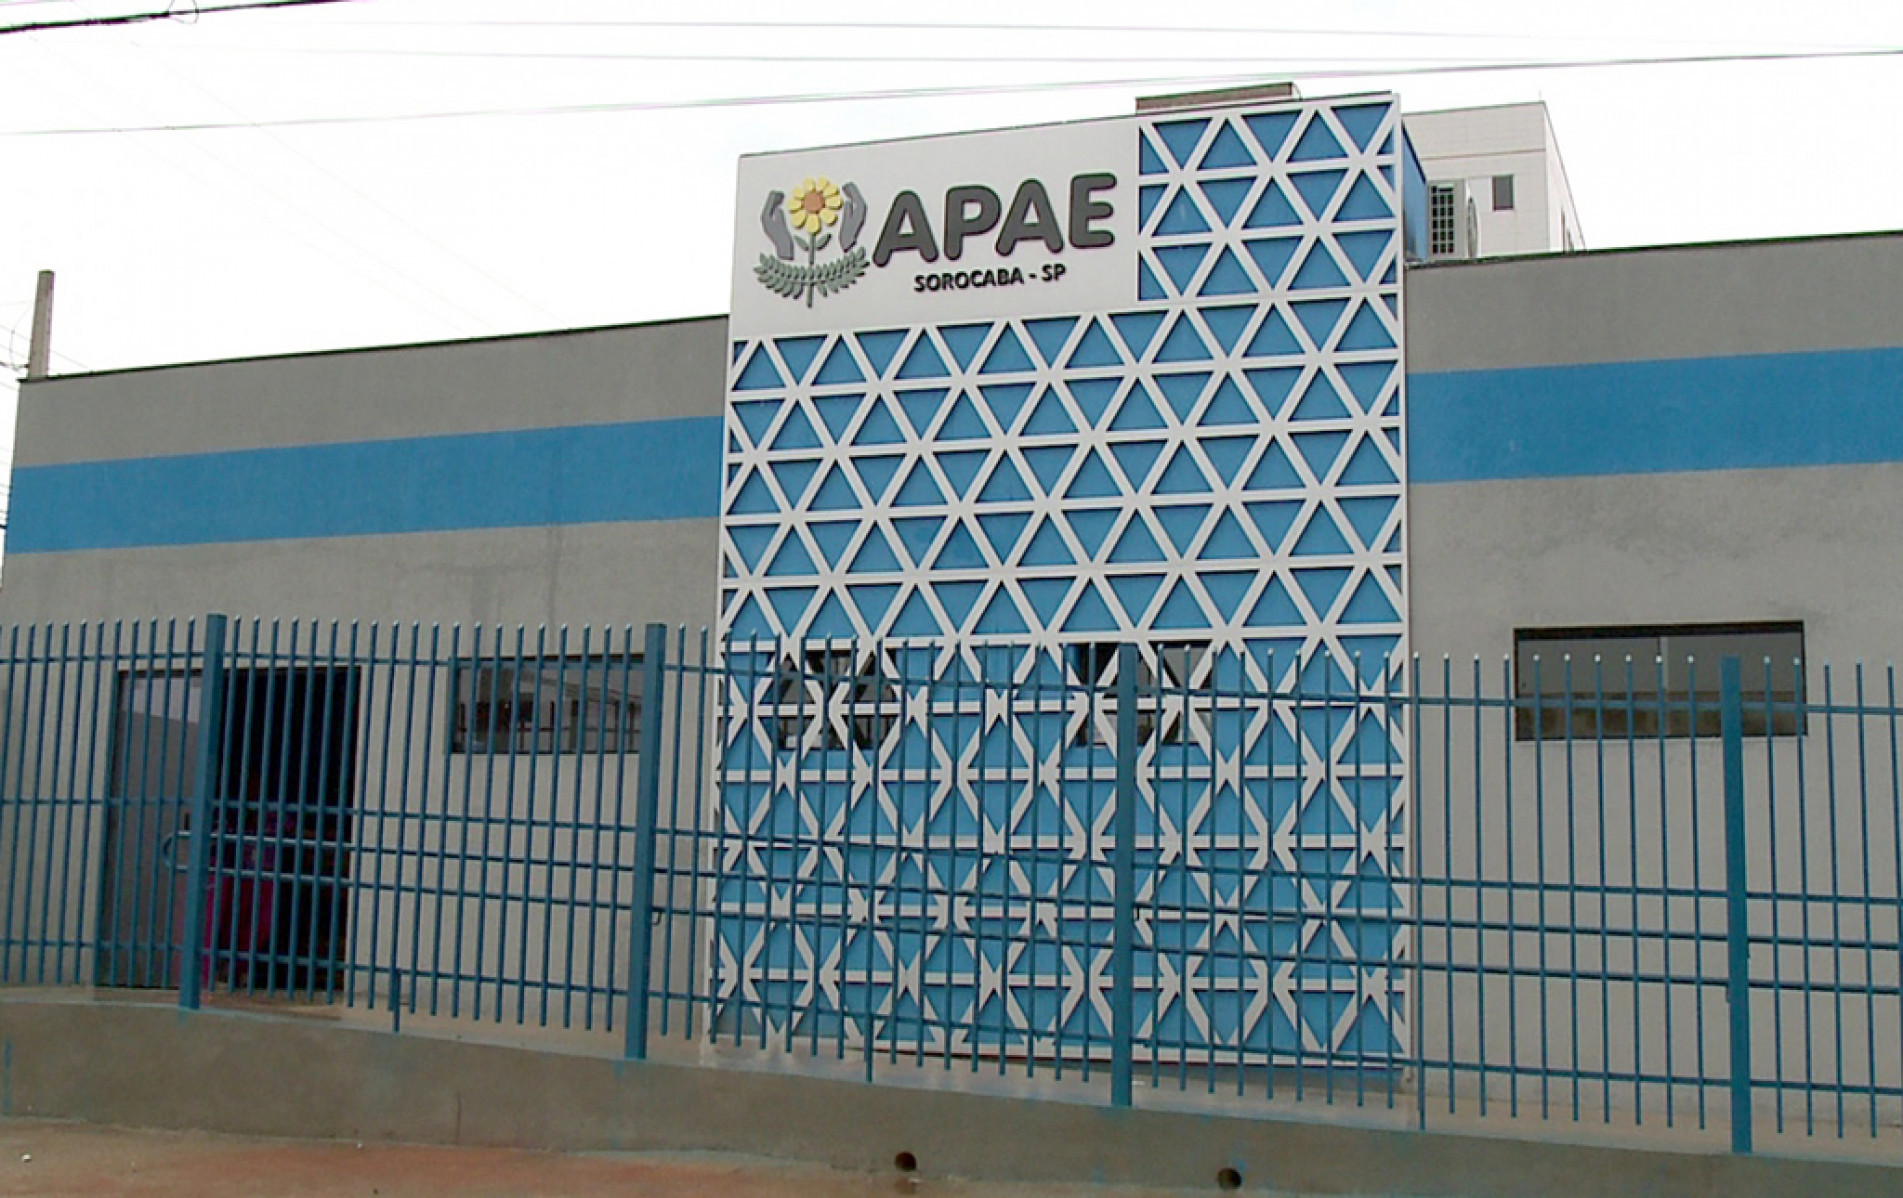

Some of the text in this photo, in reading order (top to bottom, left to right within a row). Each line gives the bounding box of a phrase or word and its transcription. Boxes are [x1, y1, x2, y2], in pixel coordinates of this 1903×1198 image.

[872, 173, 1117, 268] APAE
[914, 267, 1025, 292] SOROCABA
[1041, 263, 1067, 282] SP
